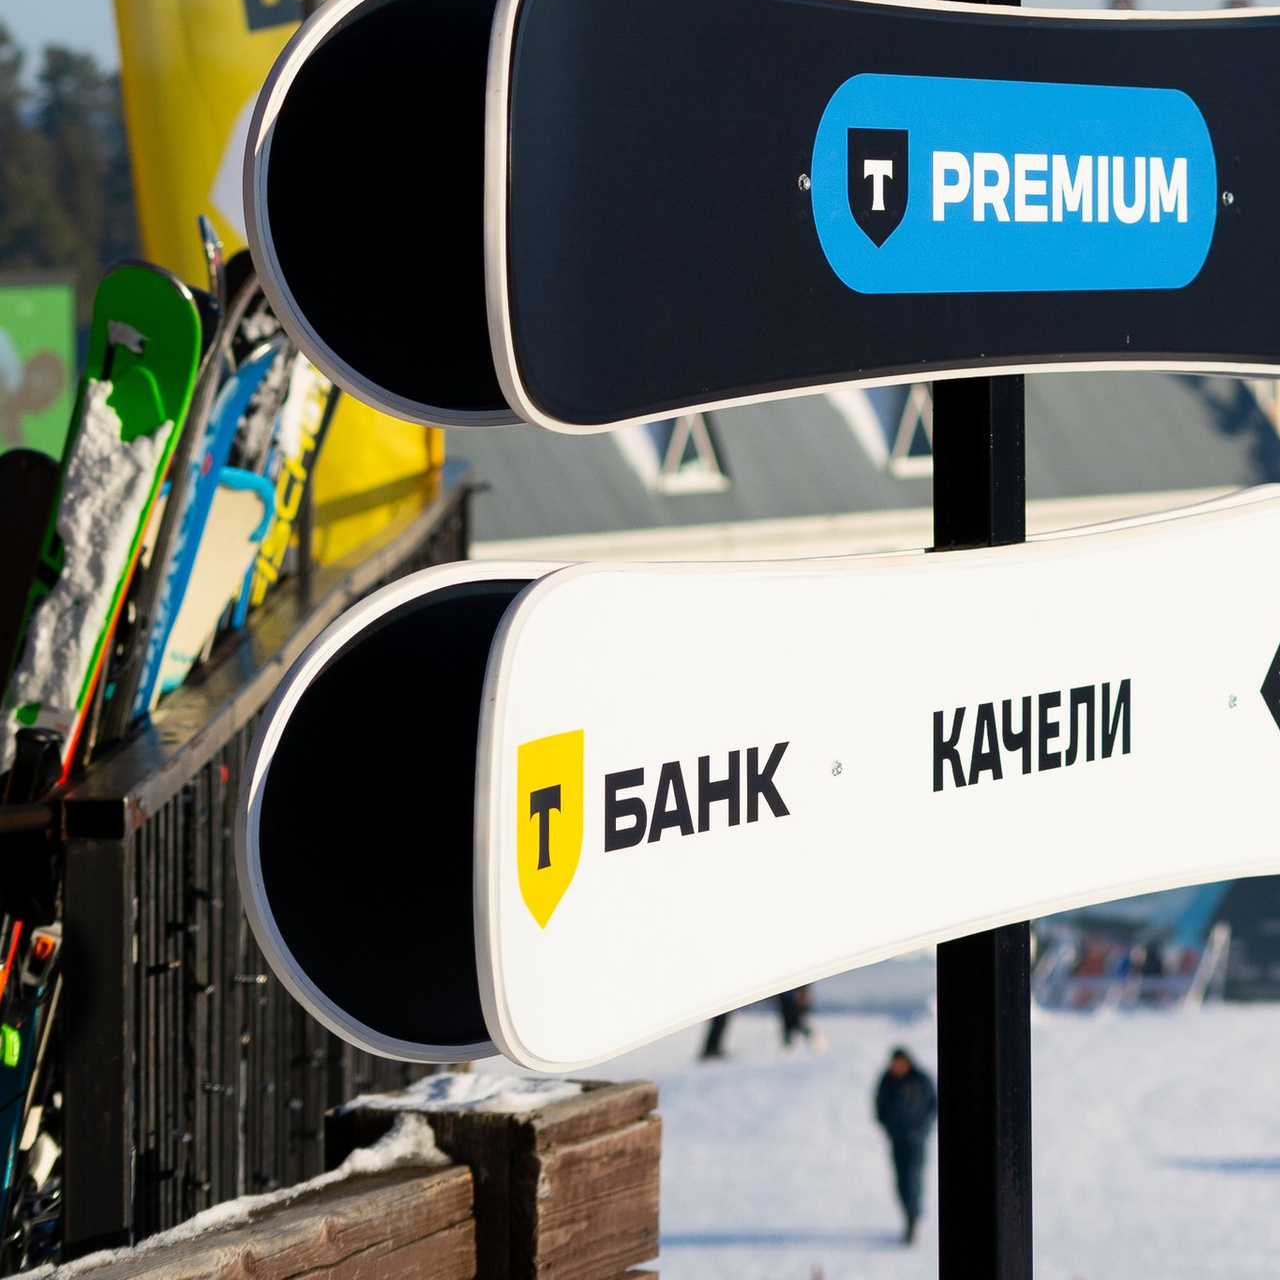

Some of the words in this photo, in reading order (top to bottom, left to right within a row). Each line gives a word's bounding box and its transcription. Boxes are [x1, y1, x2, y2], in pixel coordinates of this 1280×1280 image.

[863, 159, 894, 211] T
[932, 150, 1189, 225] PREMIUM
[931, 677, 1132, 794] КАЧЕЛИ
[528, 783, 562, 872] Т
[603, 740, 791, 854] БАНК
